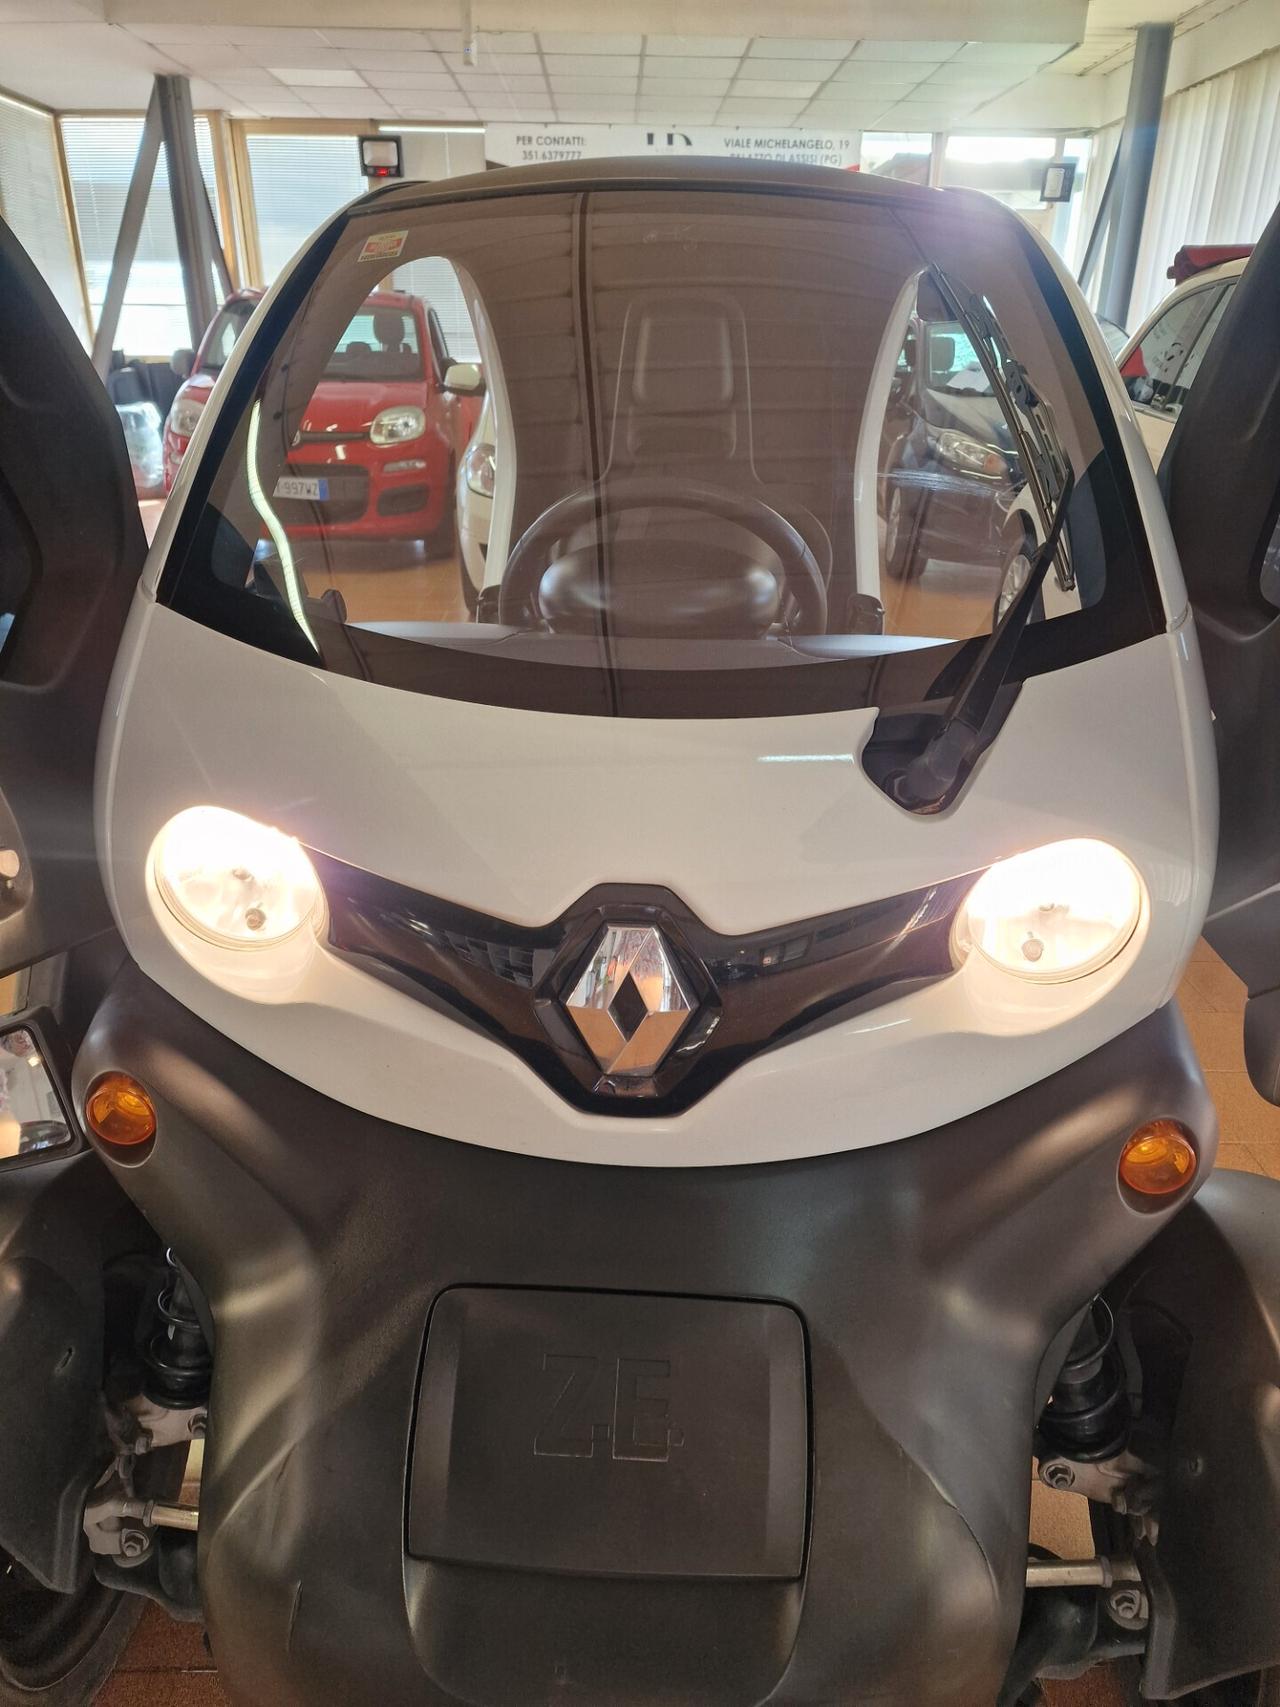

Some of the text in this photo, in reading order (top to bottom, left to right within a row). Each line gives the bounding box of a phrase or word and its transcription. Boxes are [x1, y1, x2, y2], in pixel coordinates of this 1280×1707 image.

[515, 135, 533, 146] PER
[724, 138, 751, 148] VIALE
[839, 139, 850, 149] 19
